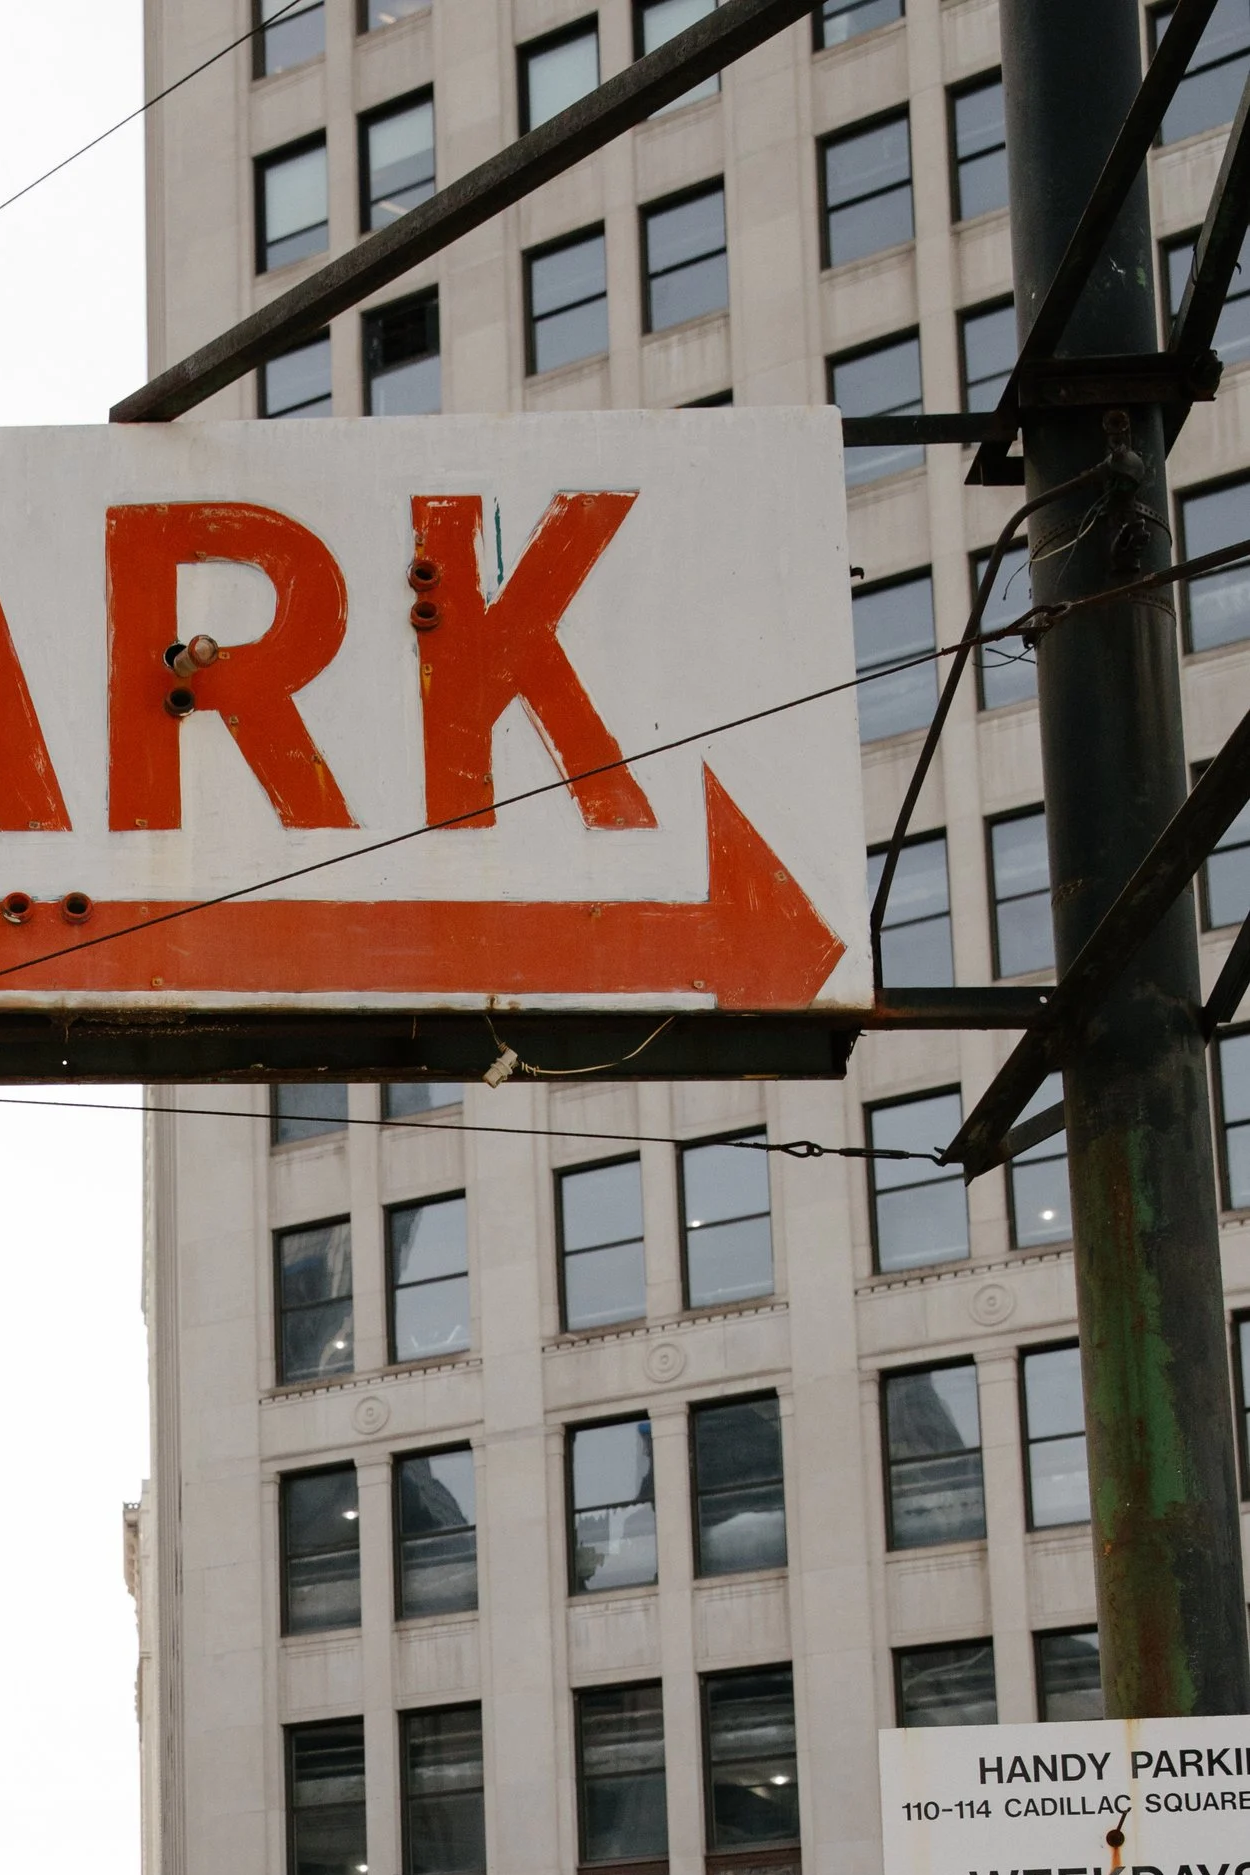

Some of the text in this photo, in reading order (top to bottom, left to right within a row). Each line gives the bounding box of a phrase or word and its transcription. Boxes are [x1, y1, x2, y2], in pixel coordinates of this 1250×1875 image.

[979, 1748, 1250, 1784] HANDY PARKI
[902, 1791, 1250, 1821] 110-114 CADILLAC SQUARE
